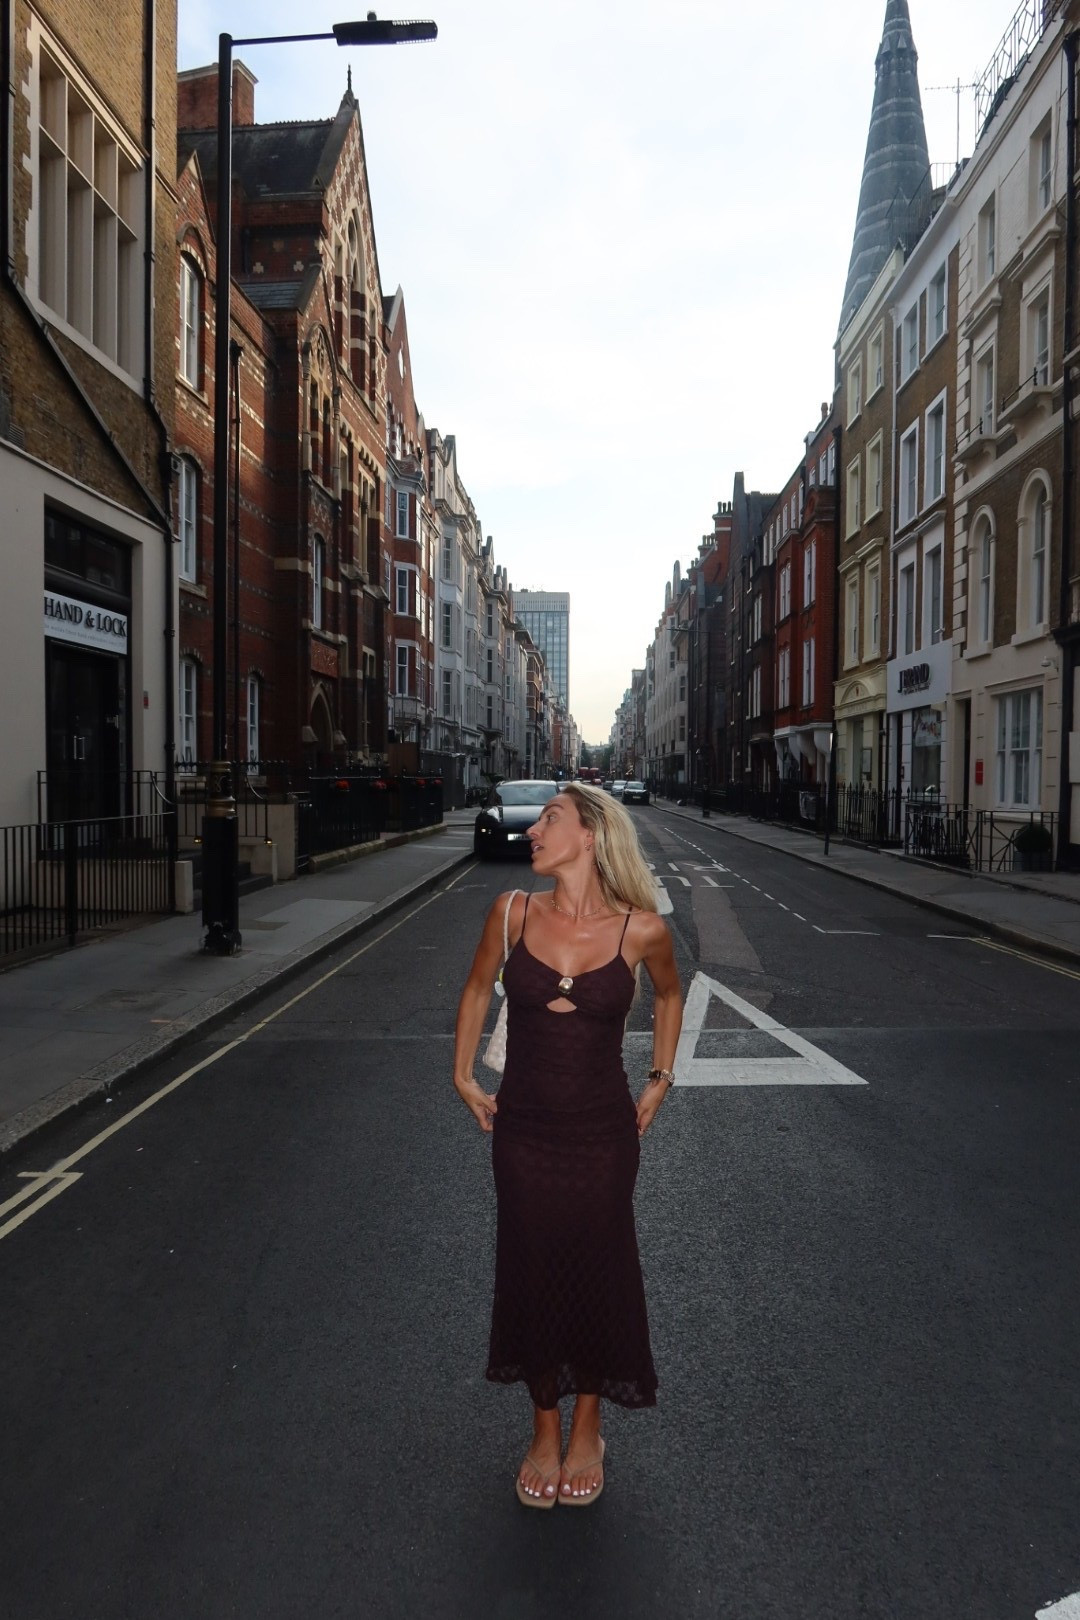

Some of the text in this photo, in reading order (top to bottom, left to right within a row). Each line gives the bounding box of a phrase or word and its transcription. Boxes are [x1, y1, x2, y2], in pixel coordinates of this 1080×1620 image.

[44, 597, 83, 624] HAND
[85, 610, 95, 629] &
[97, 613, 127, 637] LOCK
